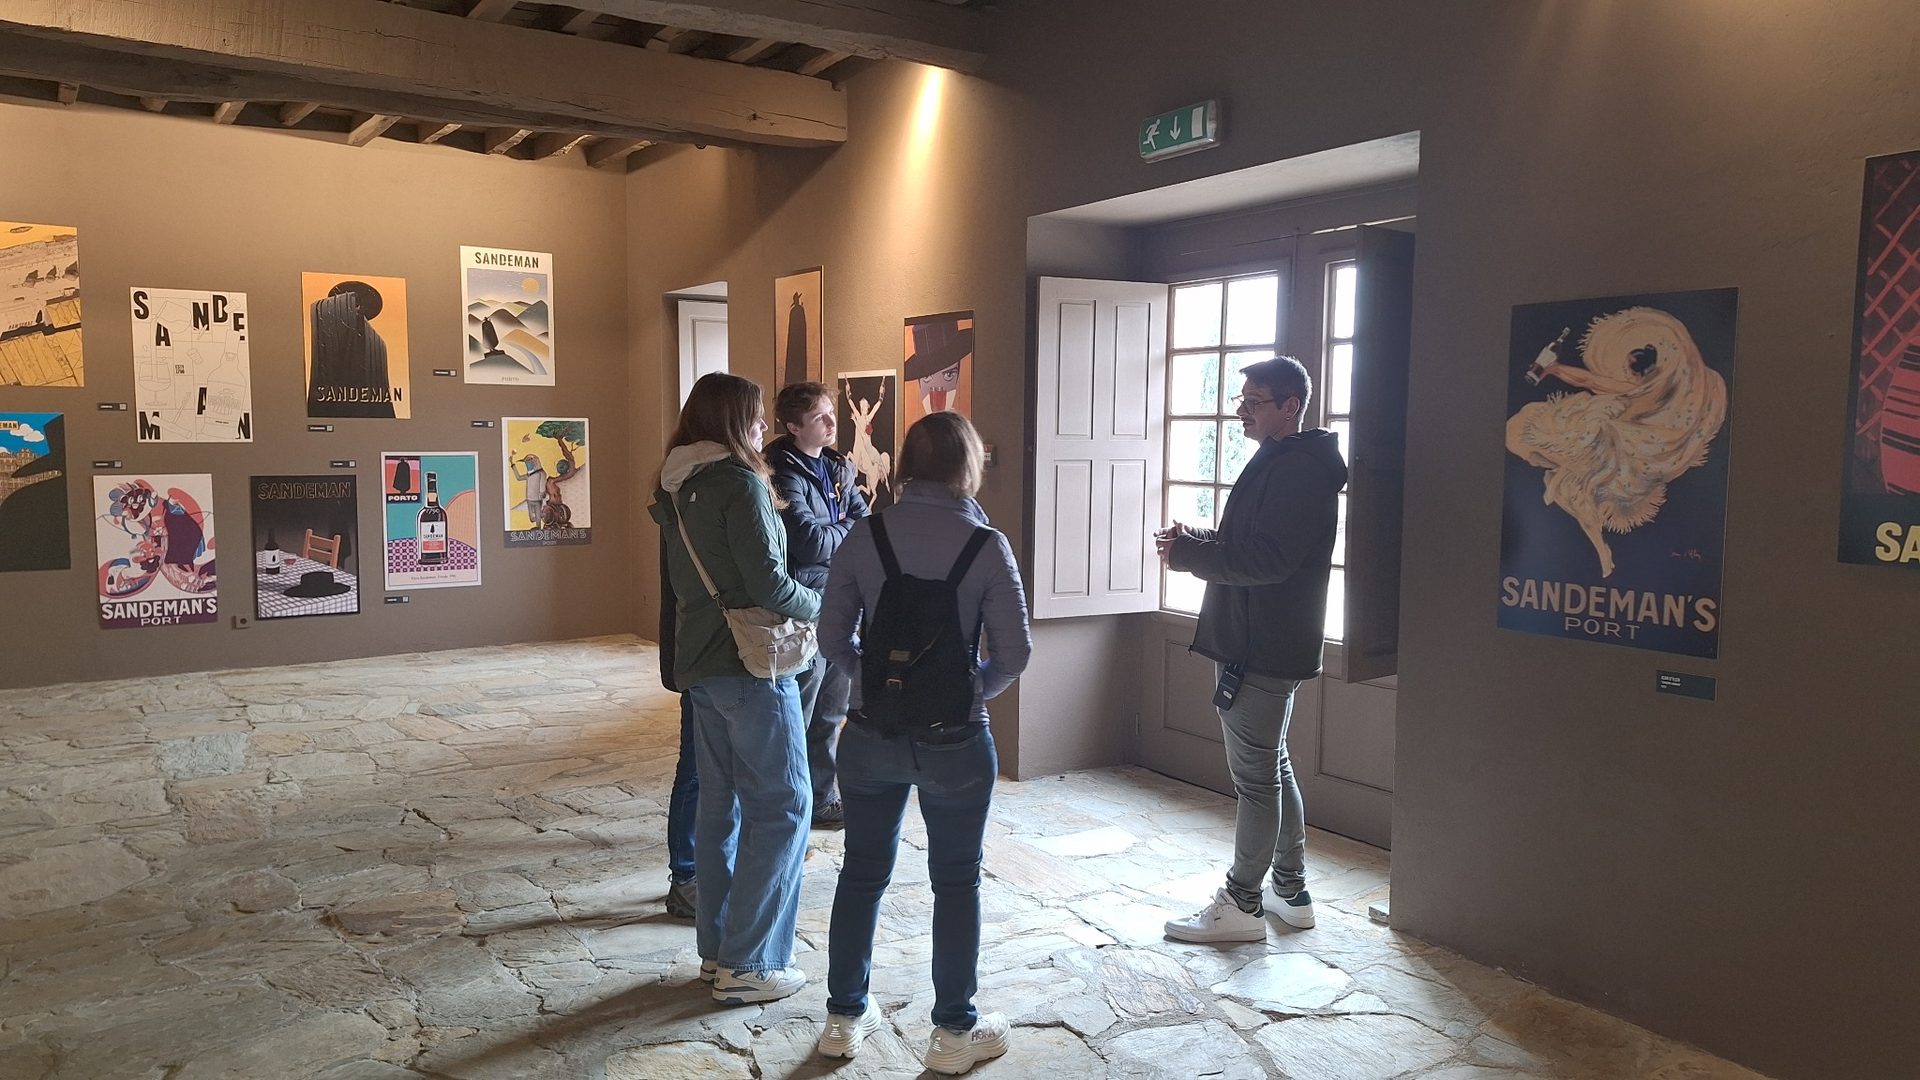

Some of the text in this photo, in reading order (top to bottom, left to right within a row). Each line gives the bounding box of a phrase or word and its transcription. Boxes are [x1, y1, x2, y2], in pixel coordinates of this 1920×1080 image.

[474, 251, 539, 269] SANDEMAN
[317, 386, 402, 403] SANDEMAN
[257, 481, 351, 500] SANDEMAN
[1875, 522, 1920, 563] SA
[101, 598, 217, 620] SANDEMAN'S
[1501, 576, 1718, 633] SANDEMAN'S
[141, 616, 182, 627] PORT
[1565, 617, 1641, 640] PORT
